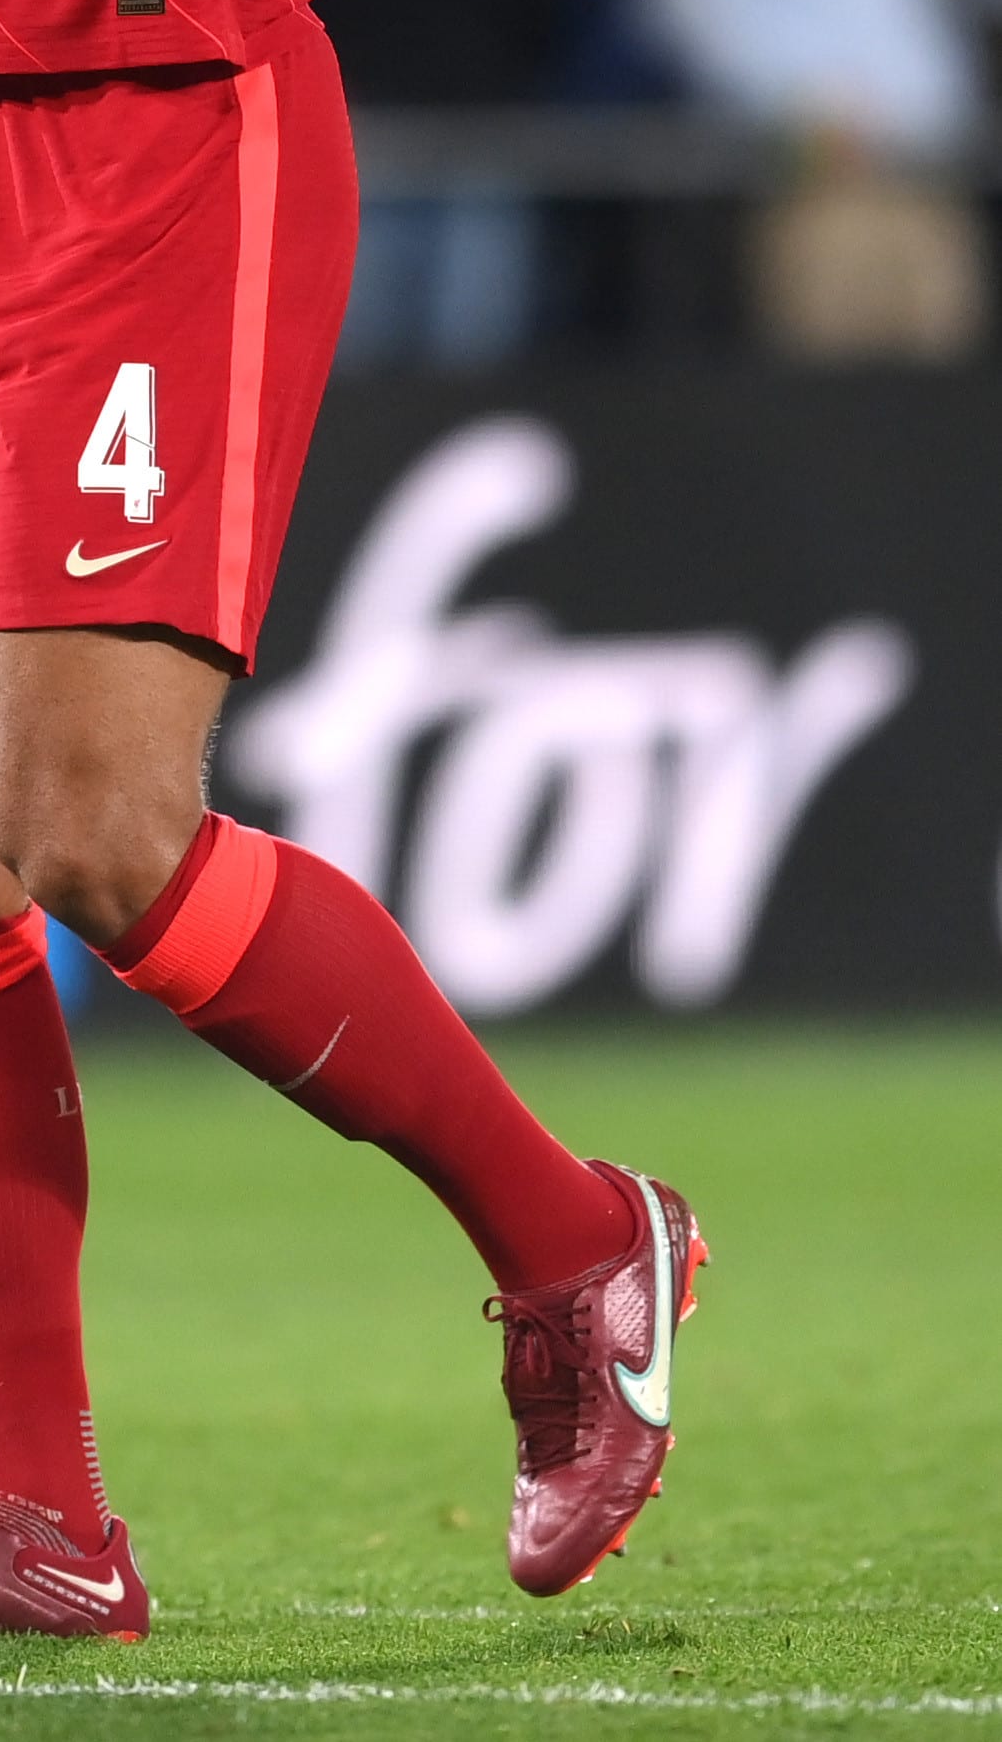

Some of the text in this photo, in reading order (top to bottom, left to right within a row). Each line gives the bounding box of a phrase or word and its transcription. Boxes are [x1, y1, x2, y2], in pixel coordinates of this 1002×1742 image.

[78, 362, 165, 523] 4
[226, 413, 918, 1020] for
[53, 1081, 84, 1118] L
